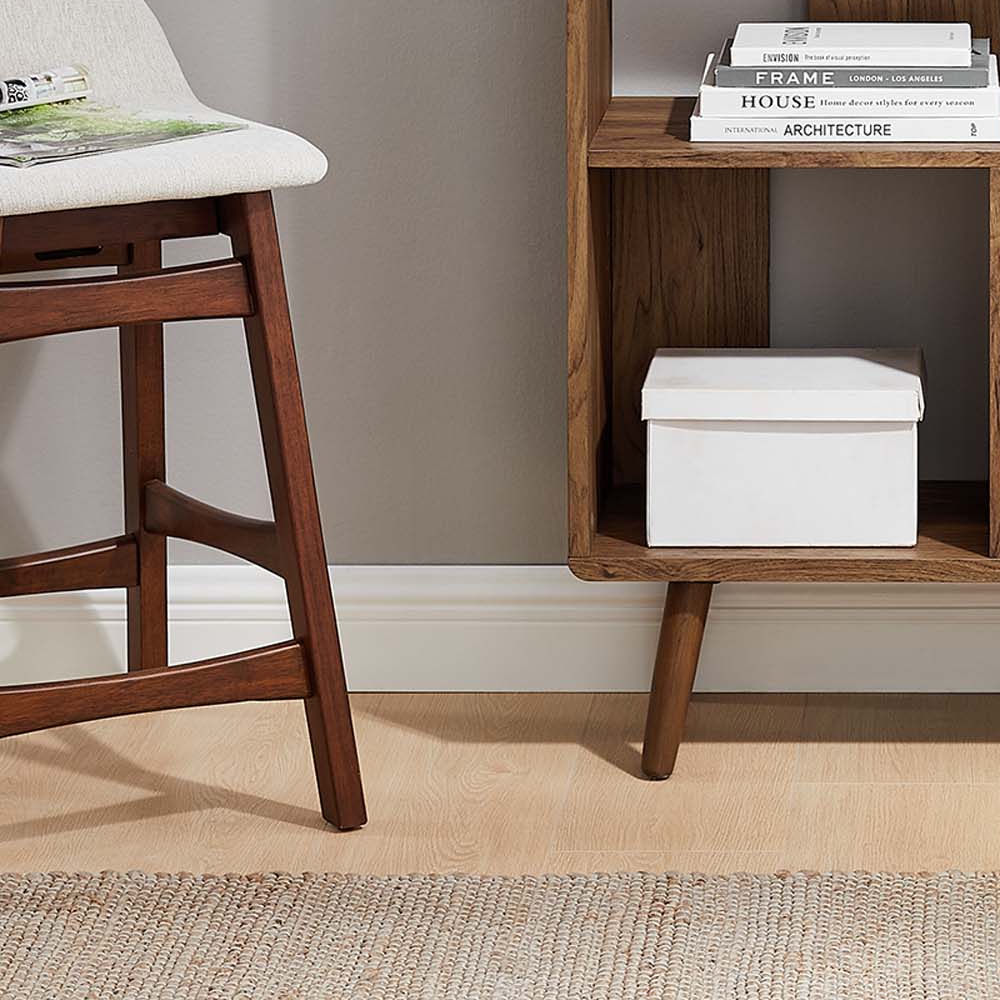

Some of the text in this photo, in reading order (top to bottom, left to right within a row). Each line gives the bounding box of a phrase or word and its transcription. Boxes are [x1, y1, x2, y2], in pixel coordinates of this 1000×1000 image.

[763, 53, 799, 63] ENVISION
[755, 71, 835, 86] FRAME
[849, 74, 884, 83] LONDON
[891, 74, 906, 83] LOS
[908, 74, 943, 83] ANGELES
[741, 95, 816, 110] HOUSE
[820, 98, 846, 107] Home
[848, 98, 874, 107] decor
[904, 98, 918, 107] for
[919, 100, 943, 109] every
[724, 127, 777, 135] INTERNATIONAL
[783, 124, 892, 137] ARCHITECTURE
